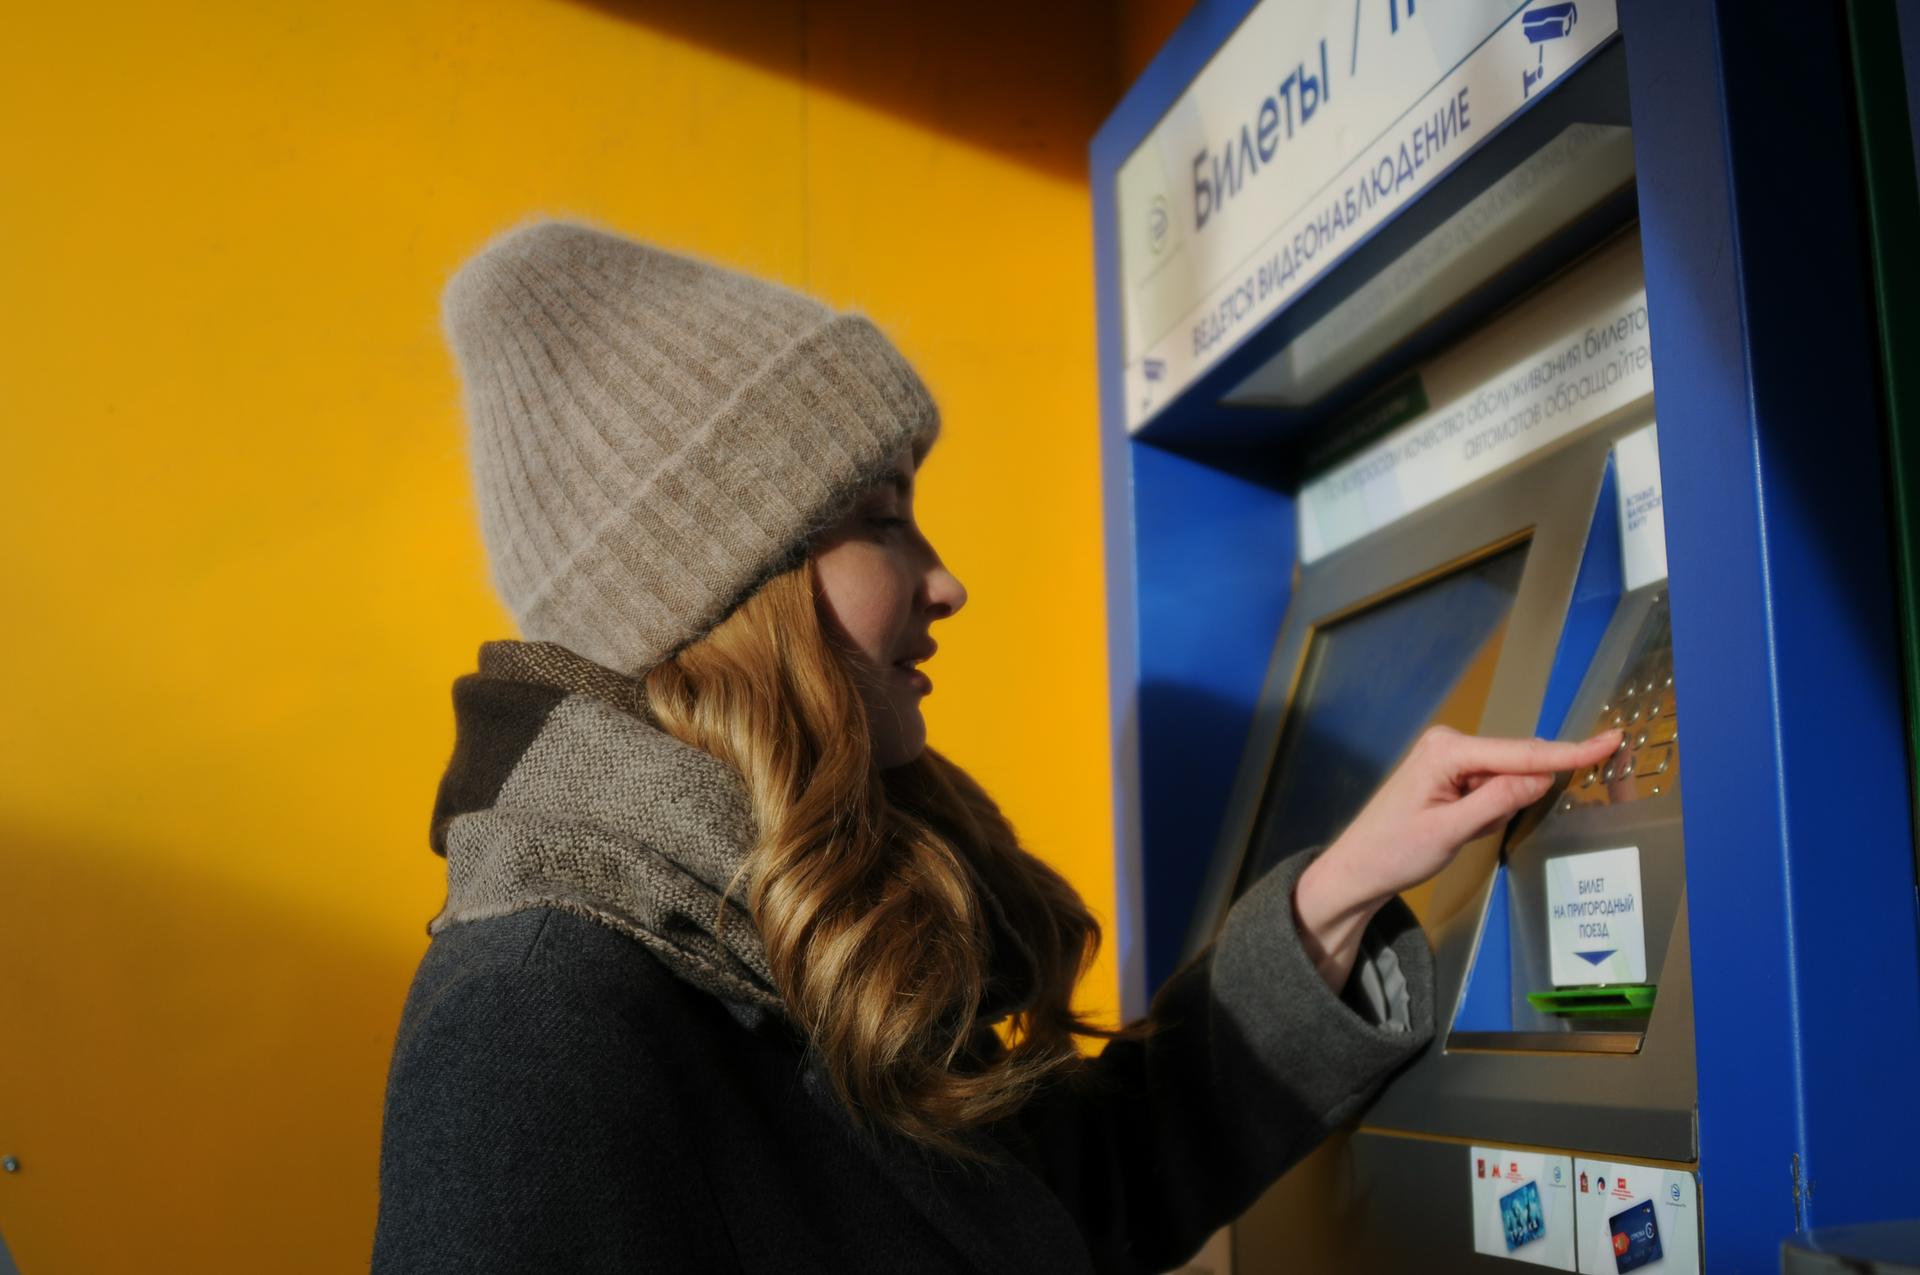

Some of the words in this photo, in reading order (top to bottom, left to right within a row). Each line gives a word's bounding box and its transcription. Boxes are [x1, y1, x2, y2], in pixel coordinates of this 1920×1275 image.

[1193, 38, 1329, 232] Билеты
[1193, 276, 1255, 358] ВЕДЕТСЯ
[1258, 86, 1470, 301] ВИДЕОНАБЛЮДЕНИЕ
[1467, 343, 1582, 425] обслуживания
[1463, 402, 1541, 461] автоматов
[1553, 906, 1566, 919] НА
[1567, 894, 1635, 919] ПРИГОРОДНЫЙ
[1578, 877, 1604, 895] БИЛЕТ
[1578, 923, 1609, 940] ПОЕЗД
